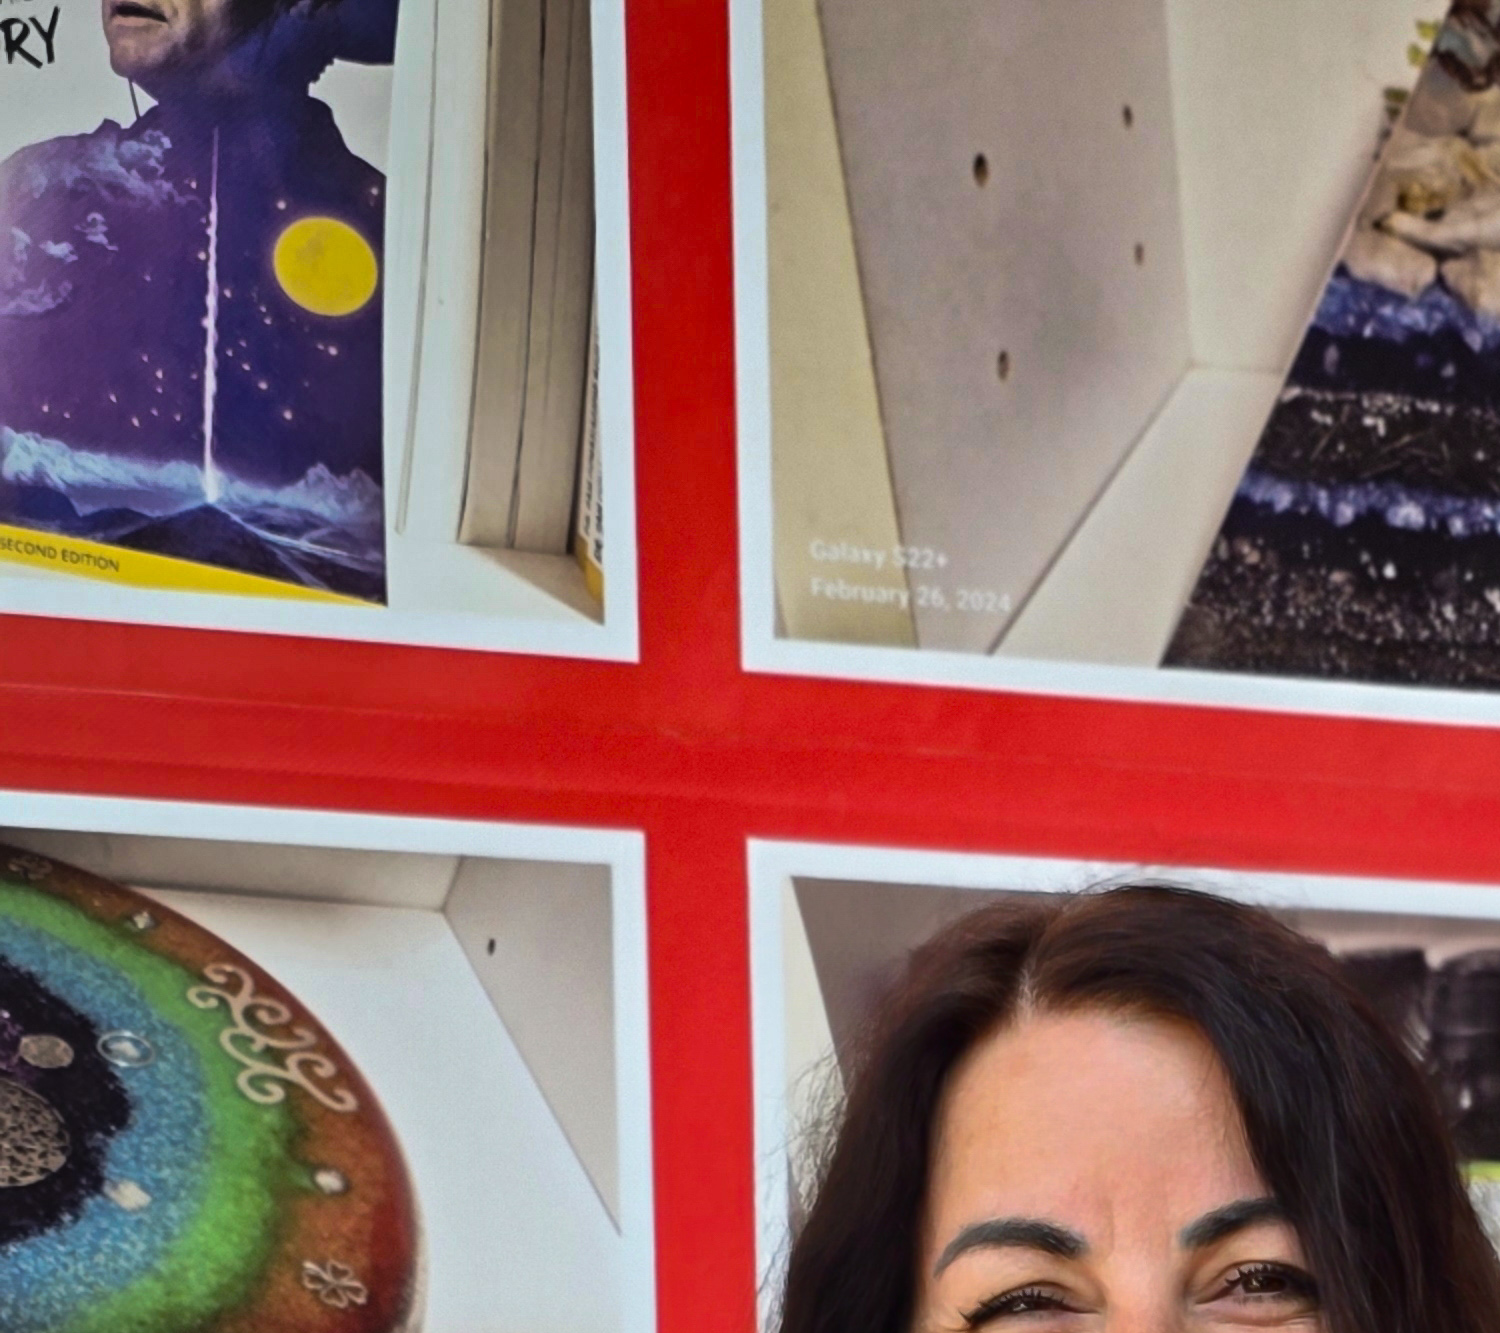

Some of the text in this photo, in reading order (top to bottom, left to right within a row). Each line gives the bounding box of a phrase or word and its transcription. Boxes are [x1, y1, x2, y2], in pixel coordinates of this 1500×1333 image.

[61, 547, 120, 573] EDITION
[808, 540, 886, 569] Galaxy
[809, 576, 910, 609] February
[956, 588, 1012, 612] 2024
